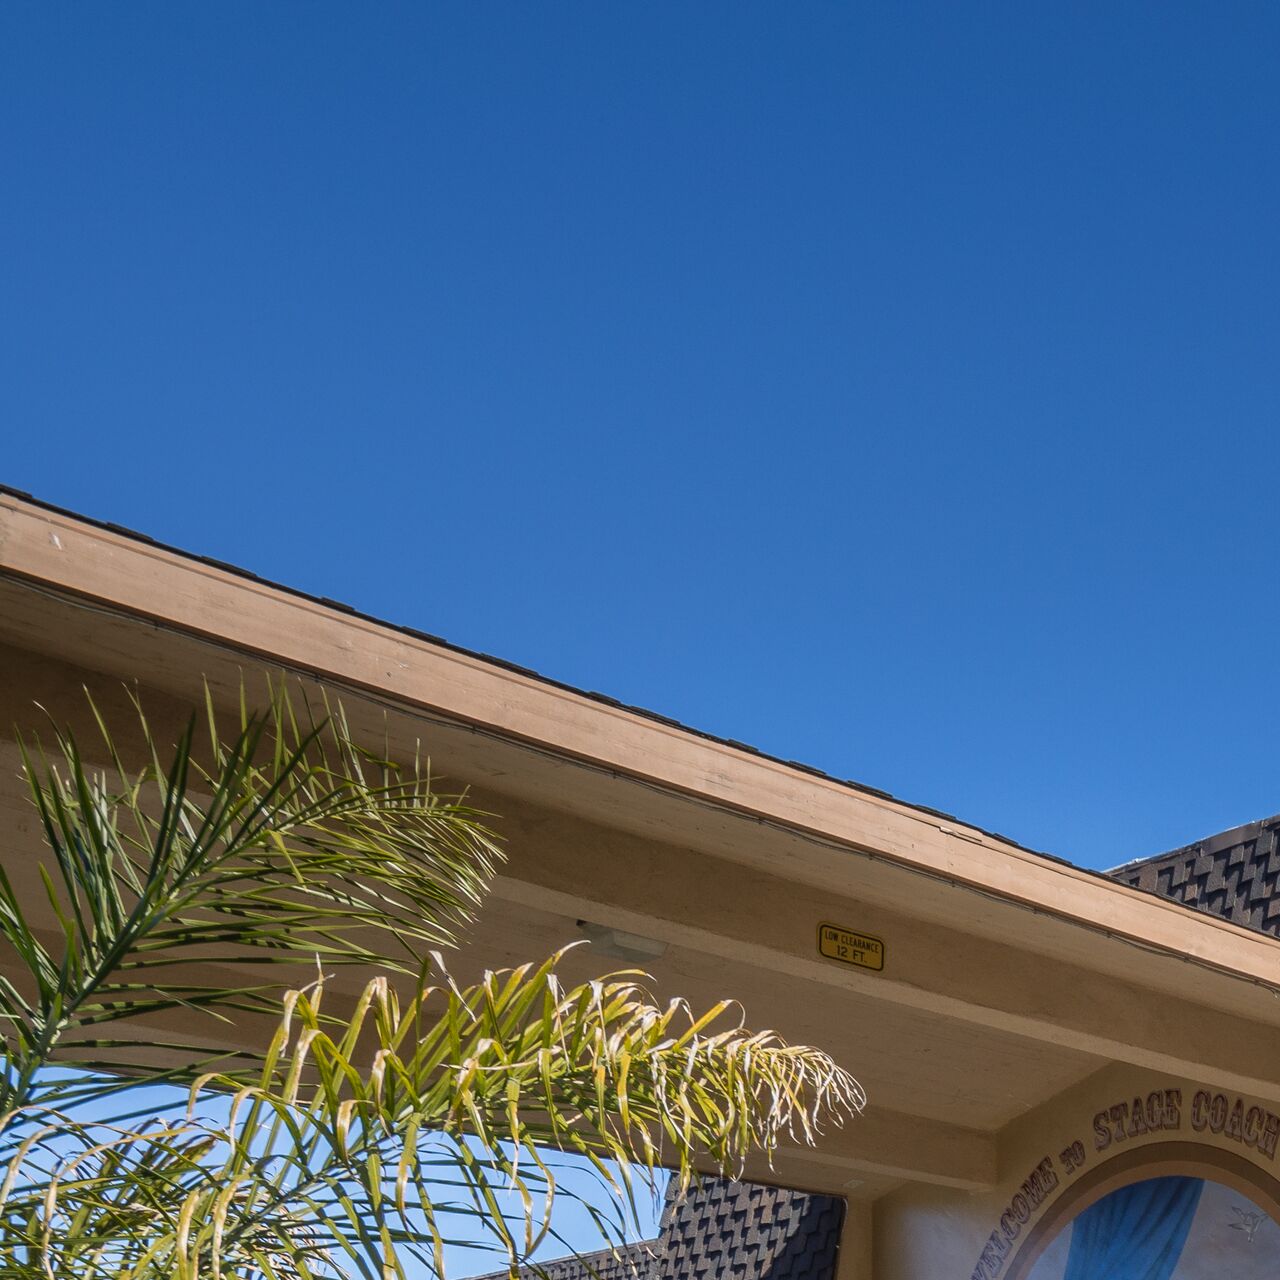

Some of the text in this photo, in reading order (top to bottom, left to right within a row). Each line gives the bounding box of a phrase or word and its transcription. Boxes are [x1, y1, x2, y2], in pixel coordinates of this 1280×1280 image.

[825, 929, 880, 953] LOW CLEARANCE
[838, 944, 868, 963] 12 FT.
[1059, 1140, 1086, 1175] TO
[1093, 1087, 1183, 1151] STAGE
